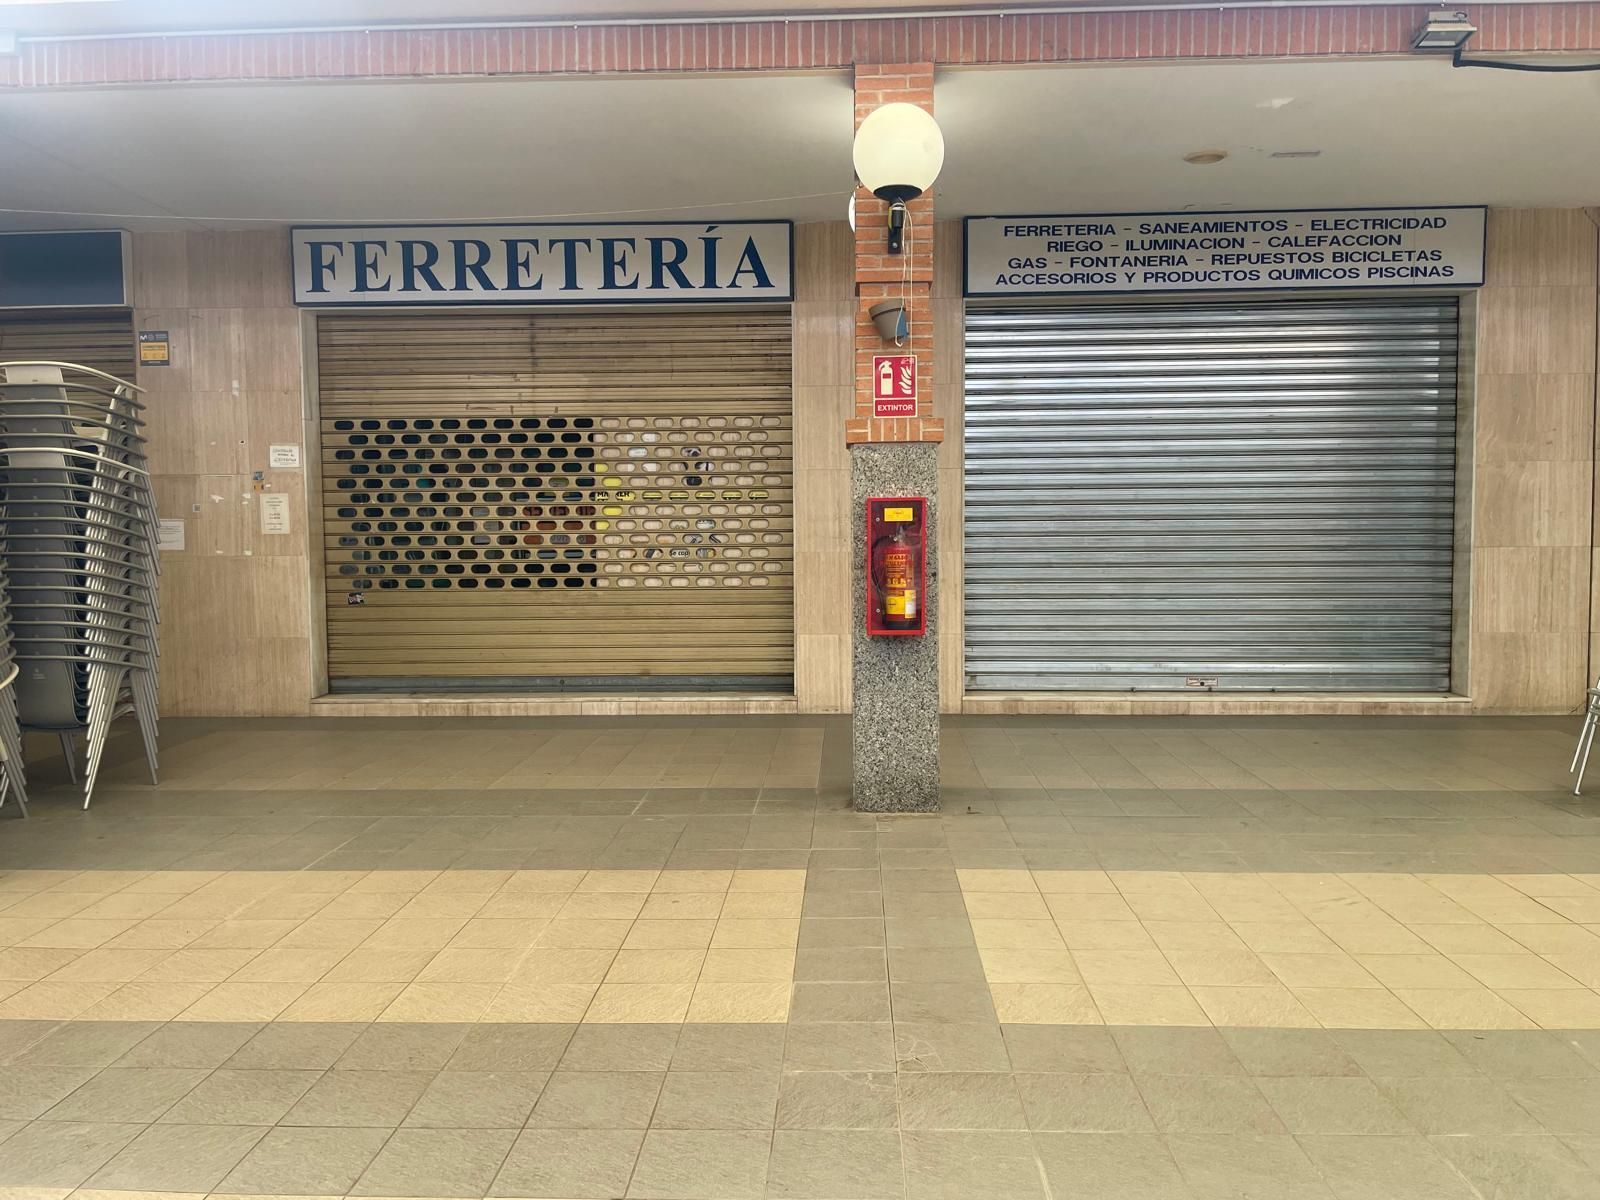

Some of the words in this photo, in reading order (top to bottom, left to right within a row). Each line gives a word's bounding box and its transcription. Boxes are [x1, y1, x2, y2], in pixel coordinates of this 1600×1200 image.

[1004, 224, 1116, 237] FERRETERIA
[1139, 220, 1288, 235] SANEAMIENTOS
[1311, 217, 1447, 231] ELECTRICIDAD
[1047, 240, 1103, 253] RIEGO
[1126, 237, 1245, 251] ILUMINACION
[1268, 234, 1402, 248] CALEFACCION
[304, 226, 776, 292] FERRETERÍA
[1008, 257, 1047, 269] GAS
[1070, 255, 1188, 268] FONTANERIA
[1211, 252, 1324, 265] REPUESTOS
[1332, 250, 1442, 263] BICICLETAS
[996, 272, 1116, 286] ACCESORIOS
[1124, 272, 1136, 284] Y
[1144, 270, 1260, 283] PRODUCTOS
[1268, 268, 1360, 281] QUIMICOS
[1368, 266, 1454, 279] PISCINAS
[878, 404, 913, 412] EXTINTOR
